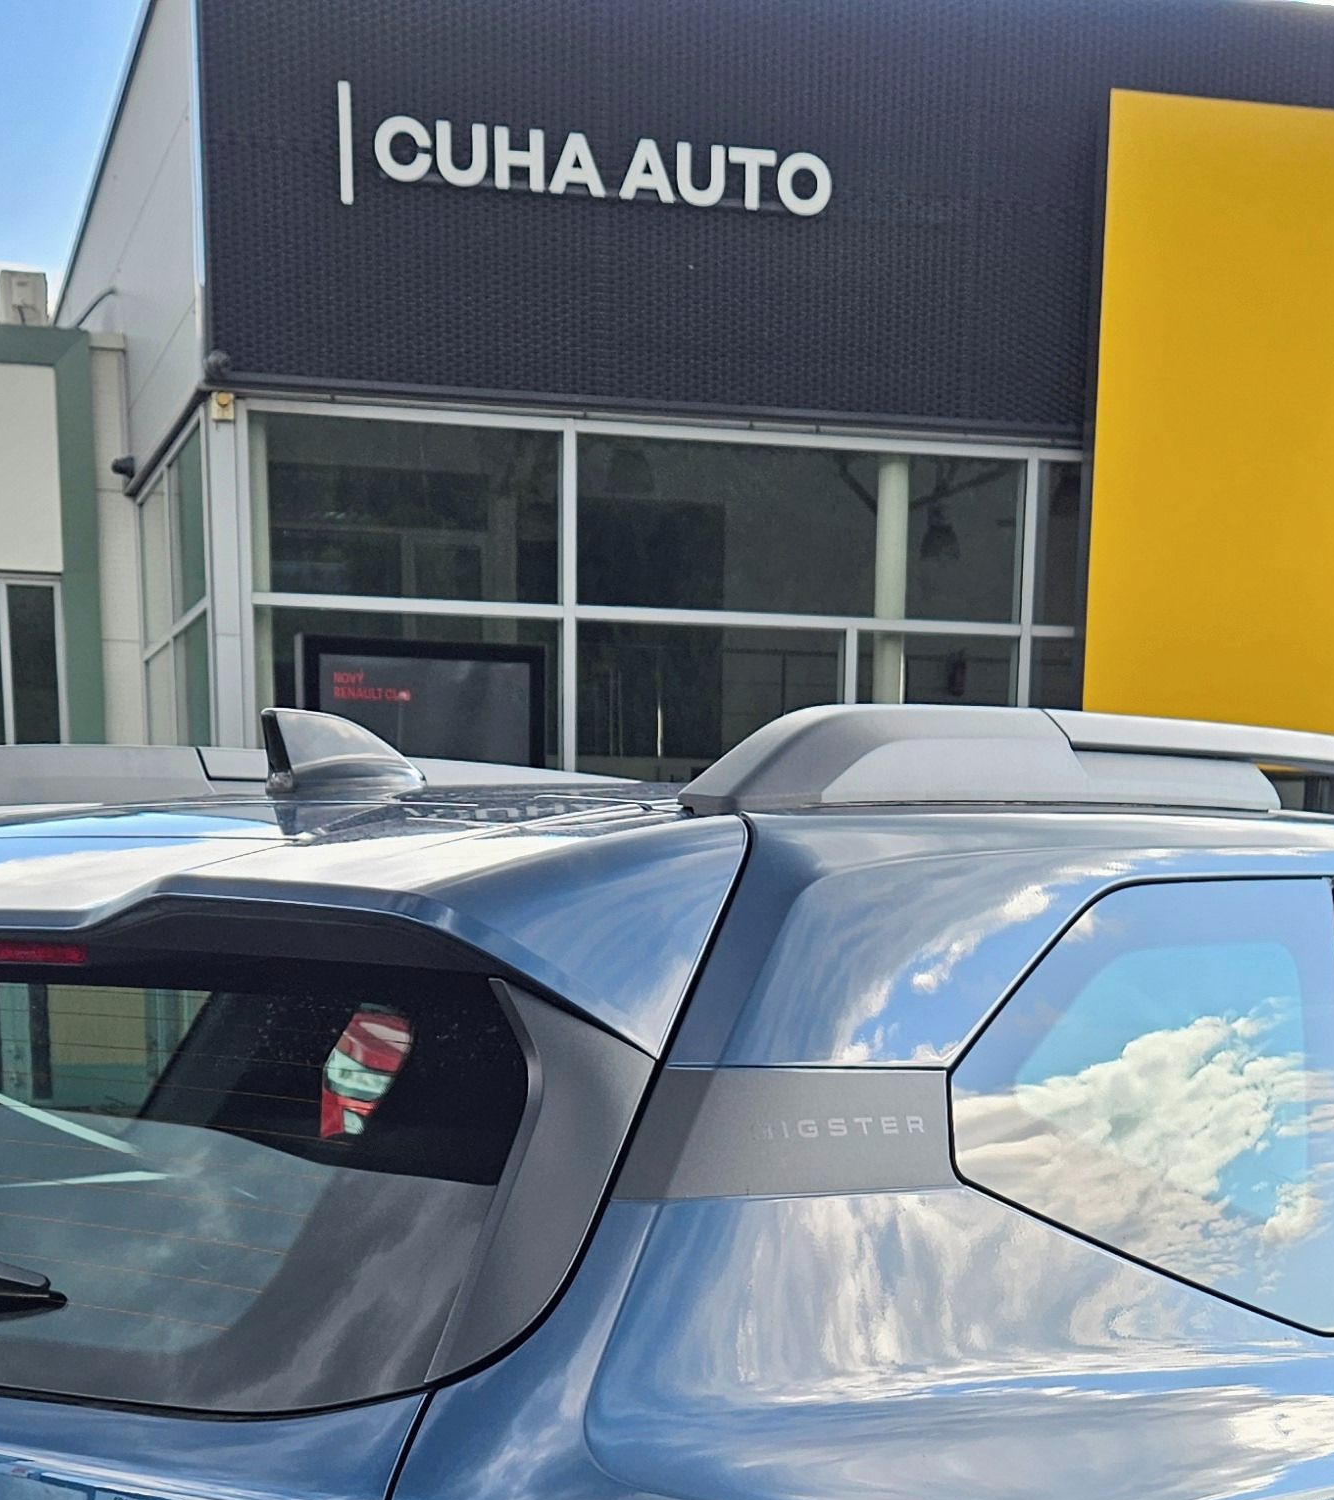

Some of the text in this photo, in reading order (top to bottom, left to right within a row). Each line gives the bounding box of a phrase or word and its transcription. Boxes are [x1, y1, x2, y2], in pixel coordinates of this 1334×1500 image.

[374, 115, 833, 216] CUHA AUTO
[333, 686, 383, 700] RENAULT
